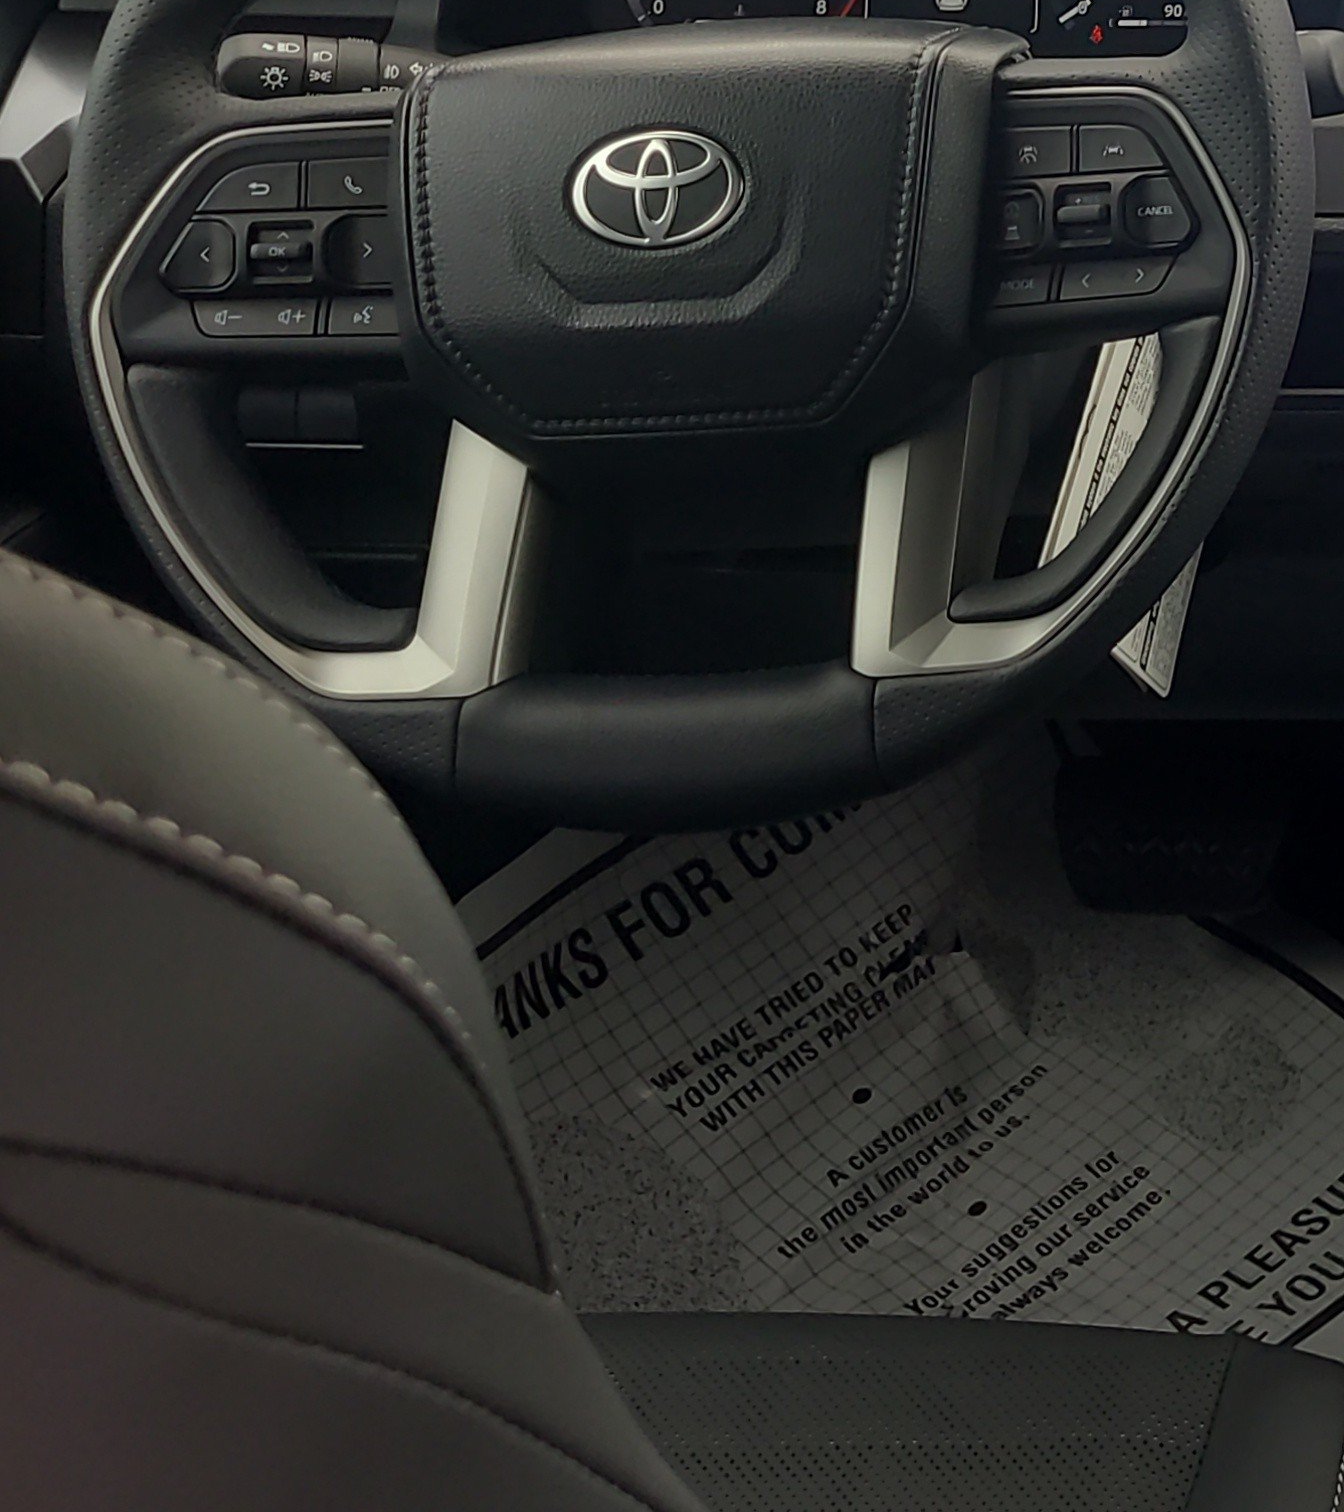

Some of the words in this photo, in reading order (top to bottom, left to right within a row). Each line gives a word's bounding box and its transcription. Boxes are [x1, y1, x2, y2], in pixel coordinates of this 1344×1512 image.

[652, 0, 665, 15] 0
[816, 0, 828, 16] 8
[1163, 3, 1184, 18] 90
[267, 245, 288, 257] OK
[1136, 204, 1175, 217] CANCEL
[494, 926, 609, 1040] ANKS
[606, 856, 736, 964] FOR
[650, 1059, 694, 1093] WE
[691, 1017, 758, 1067] HAVE
[754, 971, 825, 1027] TRIED
[823, 946, 859, 976] TO
[858, 904, 912, 954] KEEP
[666, 1062, 739, 1118] YOUR
[700, 1078, 765, 1133] WITH
[763, 1040, 819, 1087] THIS
[817, 990, 891, 1048] PAPER
[777, 1225, 819, 1260] the
[820, 1182, 878, 1231] most
[877, 1116, 979, 1193] important
[977, 1063, 1048, 1125] person
[826, 1168, 850, 1188] A
[848, 1104, 946, 1171] customer
[944, 1085, 969, 1107] is
[840, 1232, 870, 1254] in
[867, 1201, 907, 1234] the
[907, 1155, 970, 1205] world
[968, 1140, 994, 1159] to
[995, 1112, 1032, 1138] us.
[904, 1276, 961, 1316] Your
[960, 1175, 1089, 1279] suggestions
[1084, 1150, 1121, 1180] for
[957, 1253, 1038, 1317] roving
[1034, 1223, 1075, 1258] our
[1072, 1163, 1151, 1228] service
[990, 1265, 1070, 1320] always
[1067, 1188, 1173, 1267] welcome.
[1166, 1309, 1209, 1333] A
